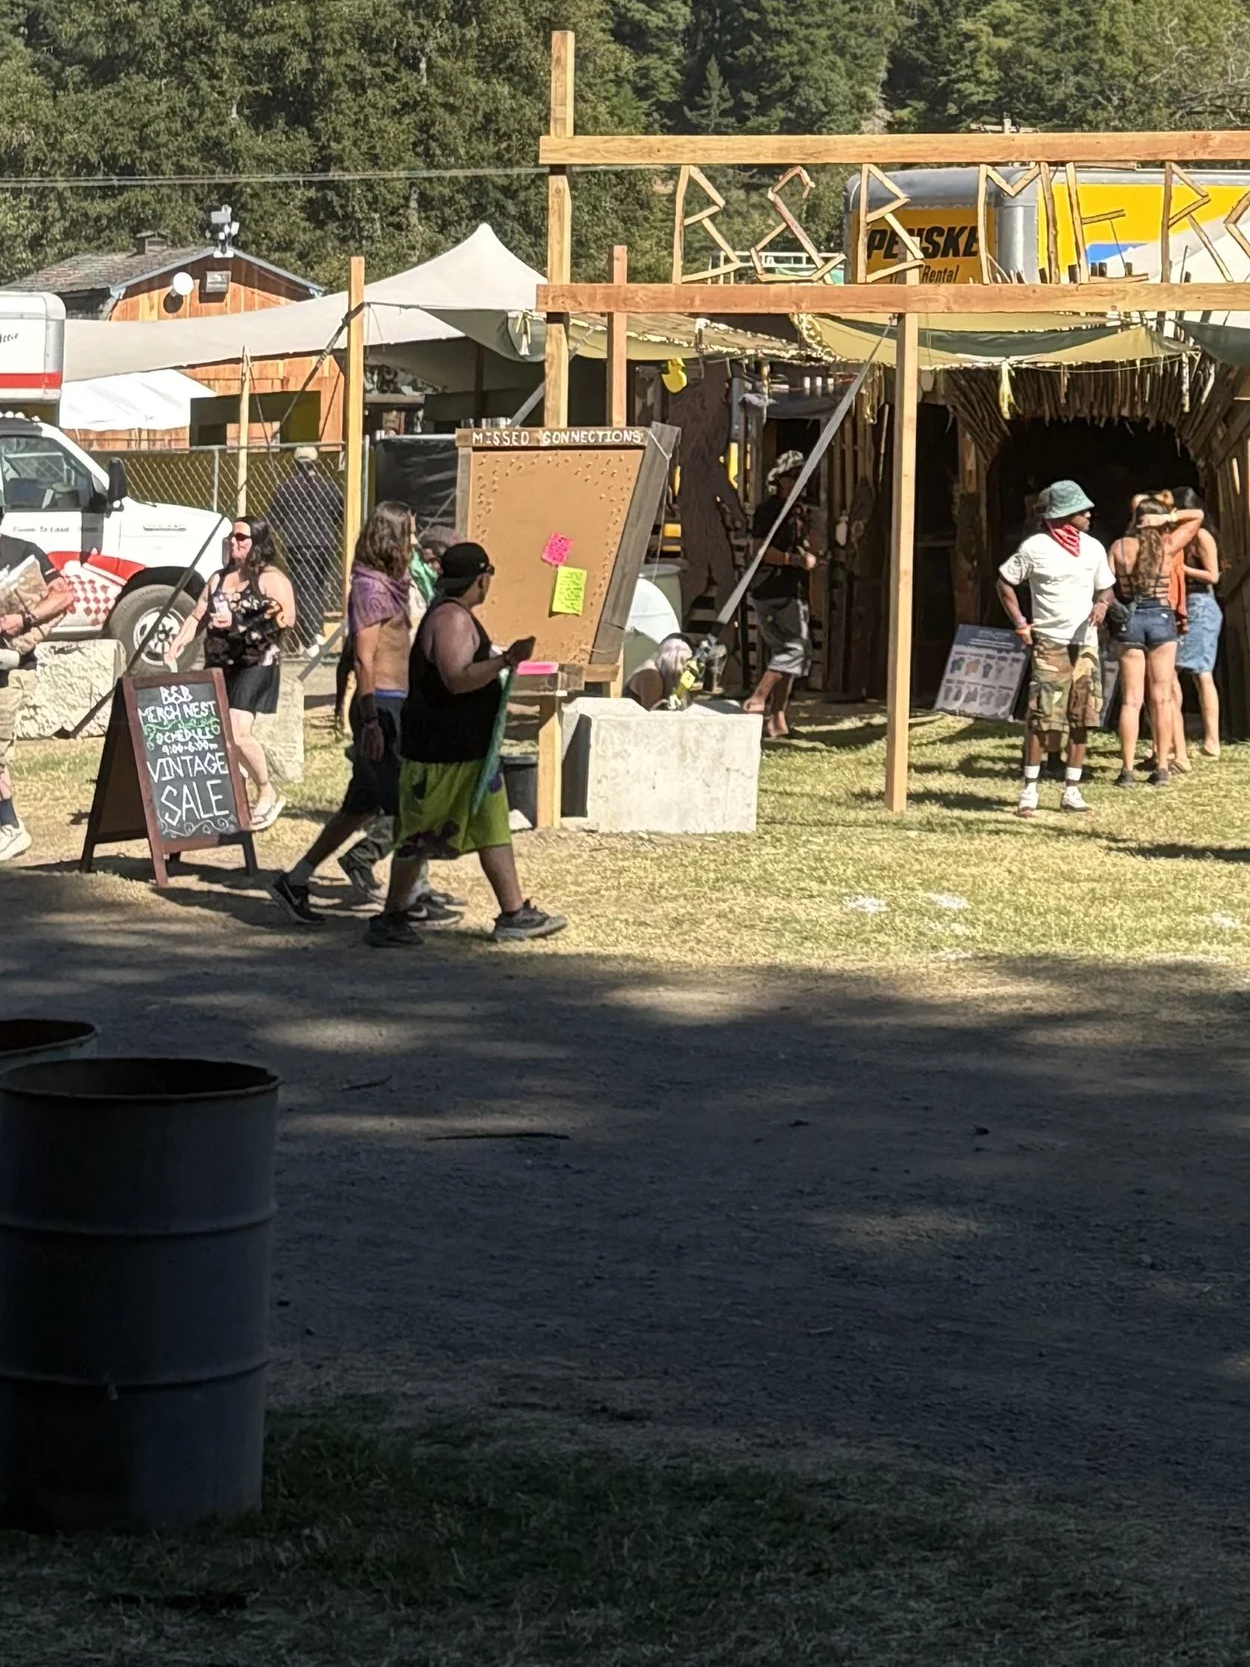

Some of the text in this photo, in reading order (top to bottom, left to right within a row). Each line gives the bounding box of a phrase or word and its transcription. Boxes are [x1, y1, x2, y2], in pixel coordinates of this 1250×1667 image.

[921, 265, 960, 284] Rental
[472, 429, 642, 446] MISSED CONNECTIONS
[182, 700, 216, 719] NEST
[146, 752, 230, 783] VINTAGE
[160, 779, 230, 826] SALE
